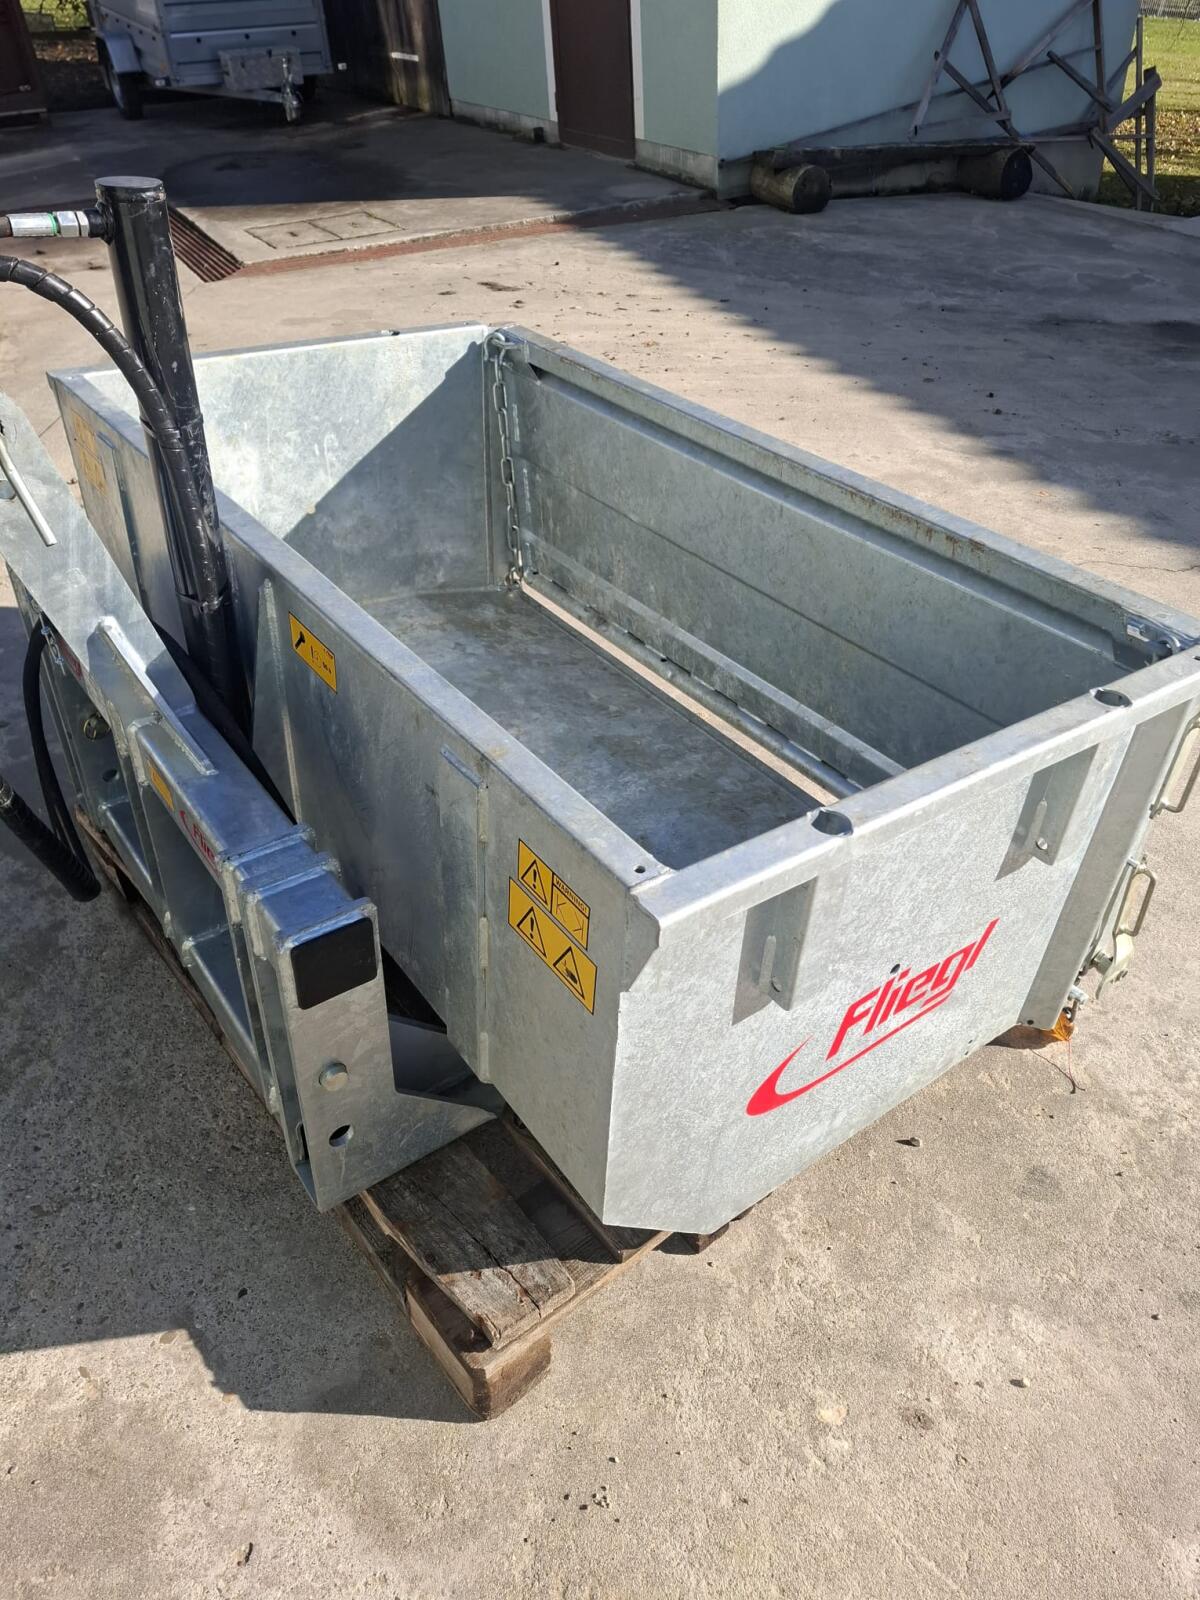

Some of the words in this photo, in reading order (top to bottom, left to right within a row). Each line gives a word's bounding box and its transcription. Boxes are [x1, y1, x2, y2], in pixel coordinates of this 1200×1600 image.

[191, 823, 217, 862] Flie
[554, 876, 589, 914] WARNING!
[825, 917, 1000, 1062] Fliegl
